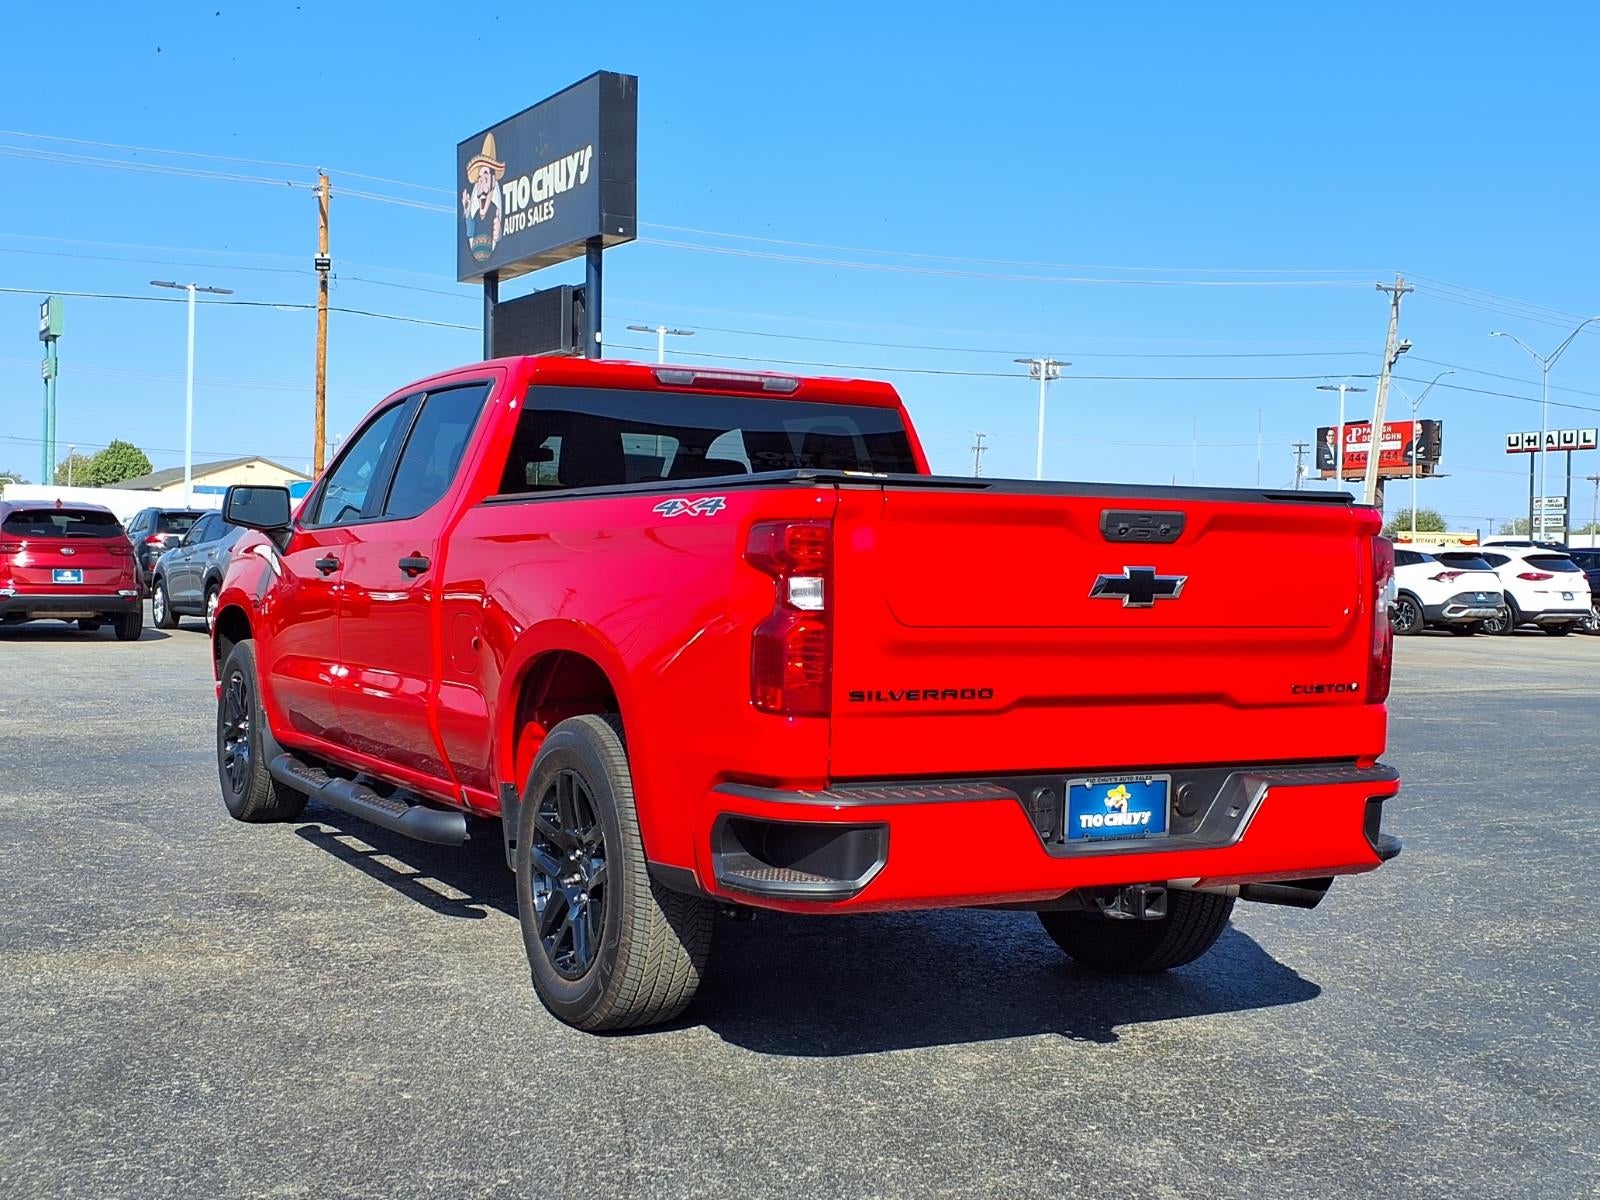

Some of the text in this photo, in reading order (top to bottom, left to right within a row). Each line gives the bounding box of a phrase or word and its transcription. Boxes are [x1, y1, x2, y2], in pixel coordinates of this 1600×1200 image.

[503, 145, 592, 215] TIO CHUY'S
[503, 200, 554, 236] AUTO SALES
[848, 688, 994, 702] SILVERADO
[1291, 683, 1359, 694] CUSTOM
[1080, 814, 1104, 828] TIO
